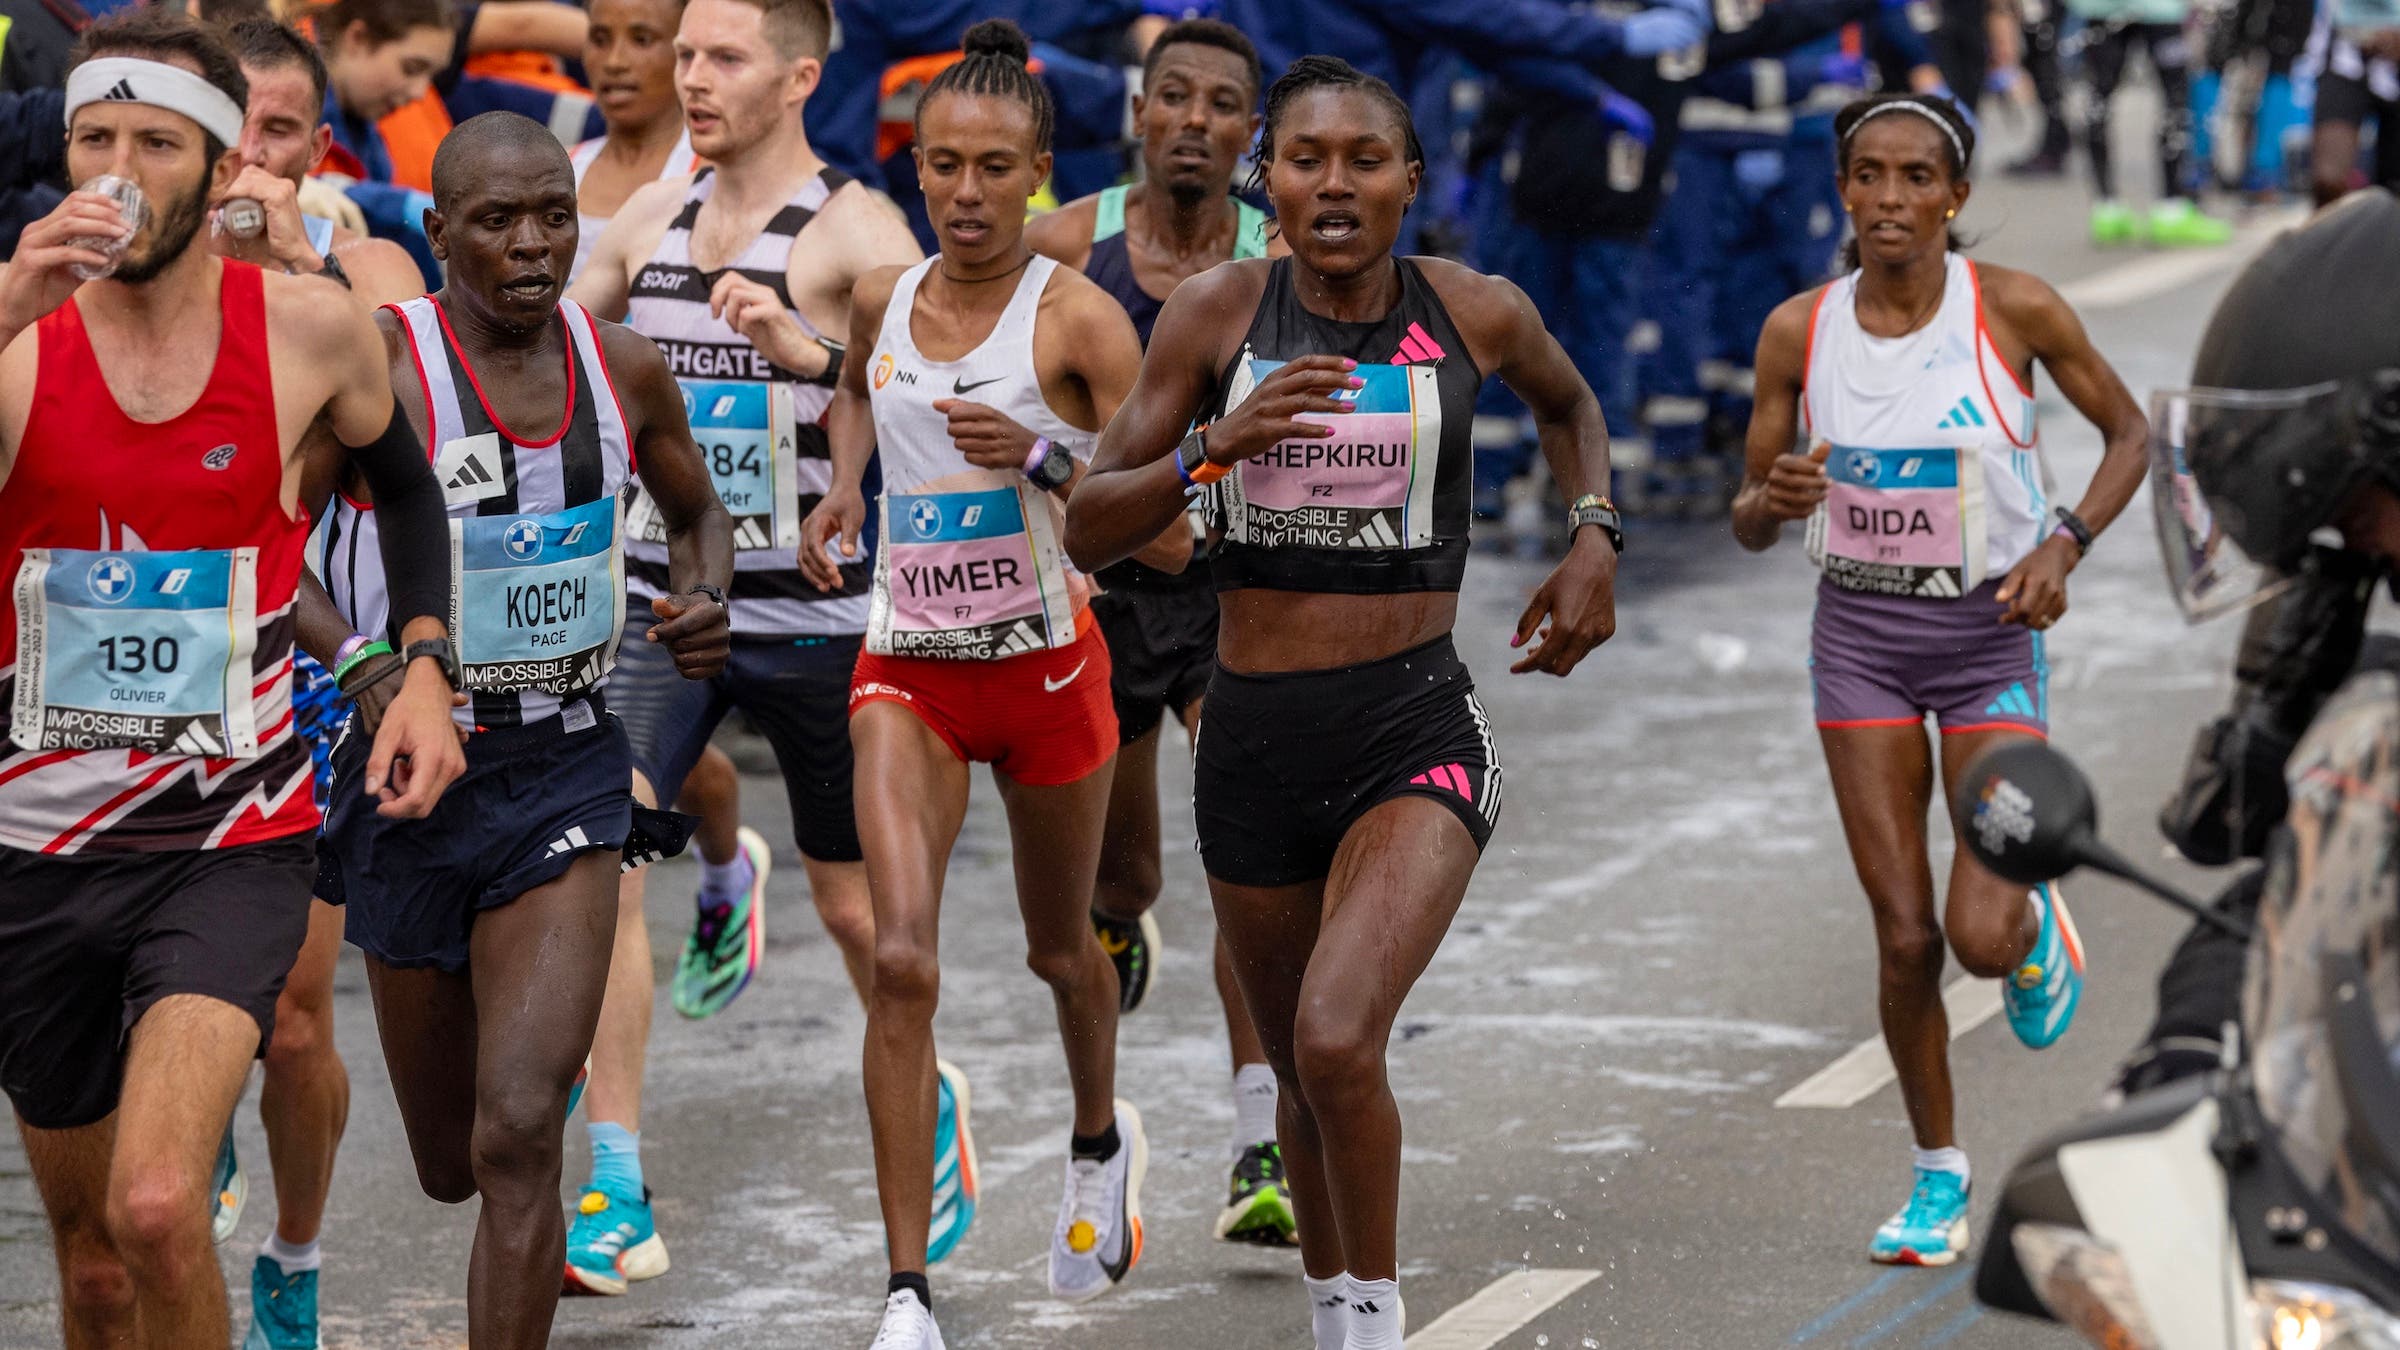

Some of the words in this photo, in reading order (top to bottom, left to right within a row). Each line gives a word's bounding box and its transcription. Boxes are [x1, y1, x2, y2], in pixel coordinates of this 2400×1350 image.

[640, 270, 689, 291] soar
[895, 371, 918, 385] NN
[779, 436, 791, 449] A
[721, 487, 752, 507] der
[1312, 485, 1333, 497] F2
[1249, 506, 1348, 529] IMPOSSIBLE
[1849, 505, 1934, 536] DIDA
[1249, 525, 1260, 543] IS
[1263, 527, 1342, 547] NOTHING
[900, 558, 1023, 598] YIMER
[506, 576, 588, 629] KOECH
[955, 605, 972, 620] F7
[33, 629, 42, 653] 2023
[531, 630, 567, 647] PACE
[894, 626, 993, 648] IMPOSSIBLE
[98, 636, 179, 674] 130
[465, 658, 573, 684] IMPOSSIBLE
[29, 656, 41, 711] September
[110, 688, 166, 704] OLIVIER
[46, 709, 165, 737] IMPOSSIBLE
[43, 730, 60, 748] IS
